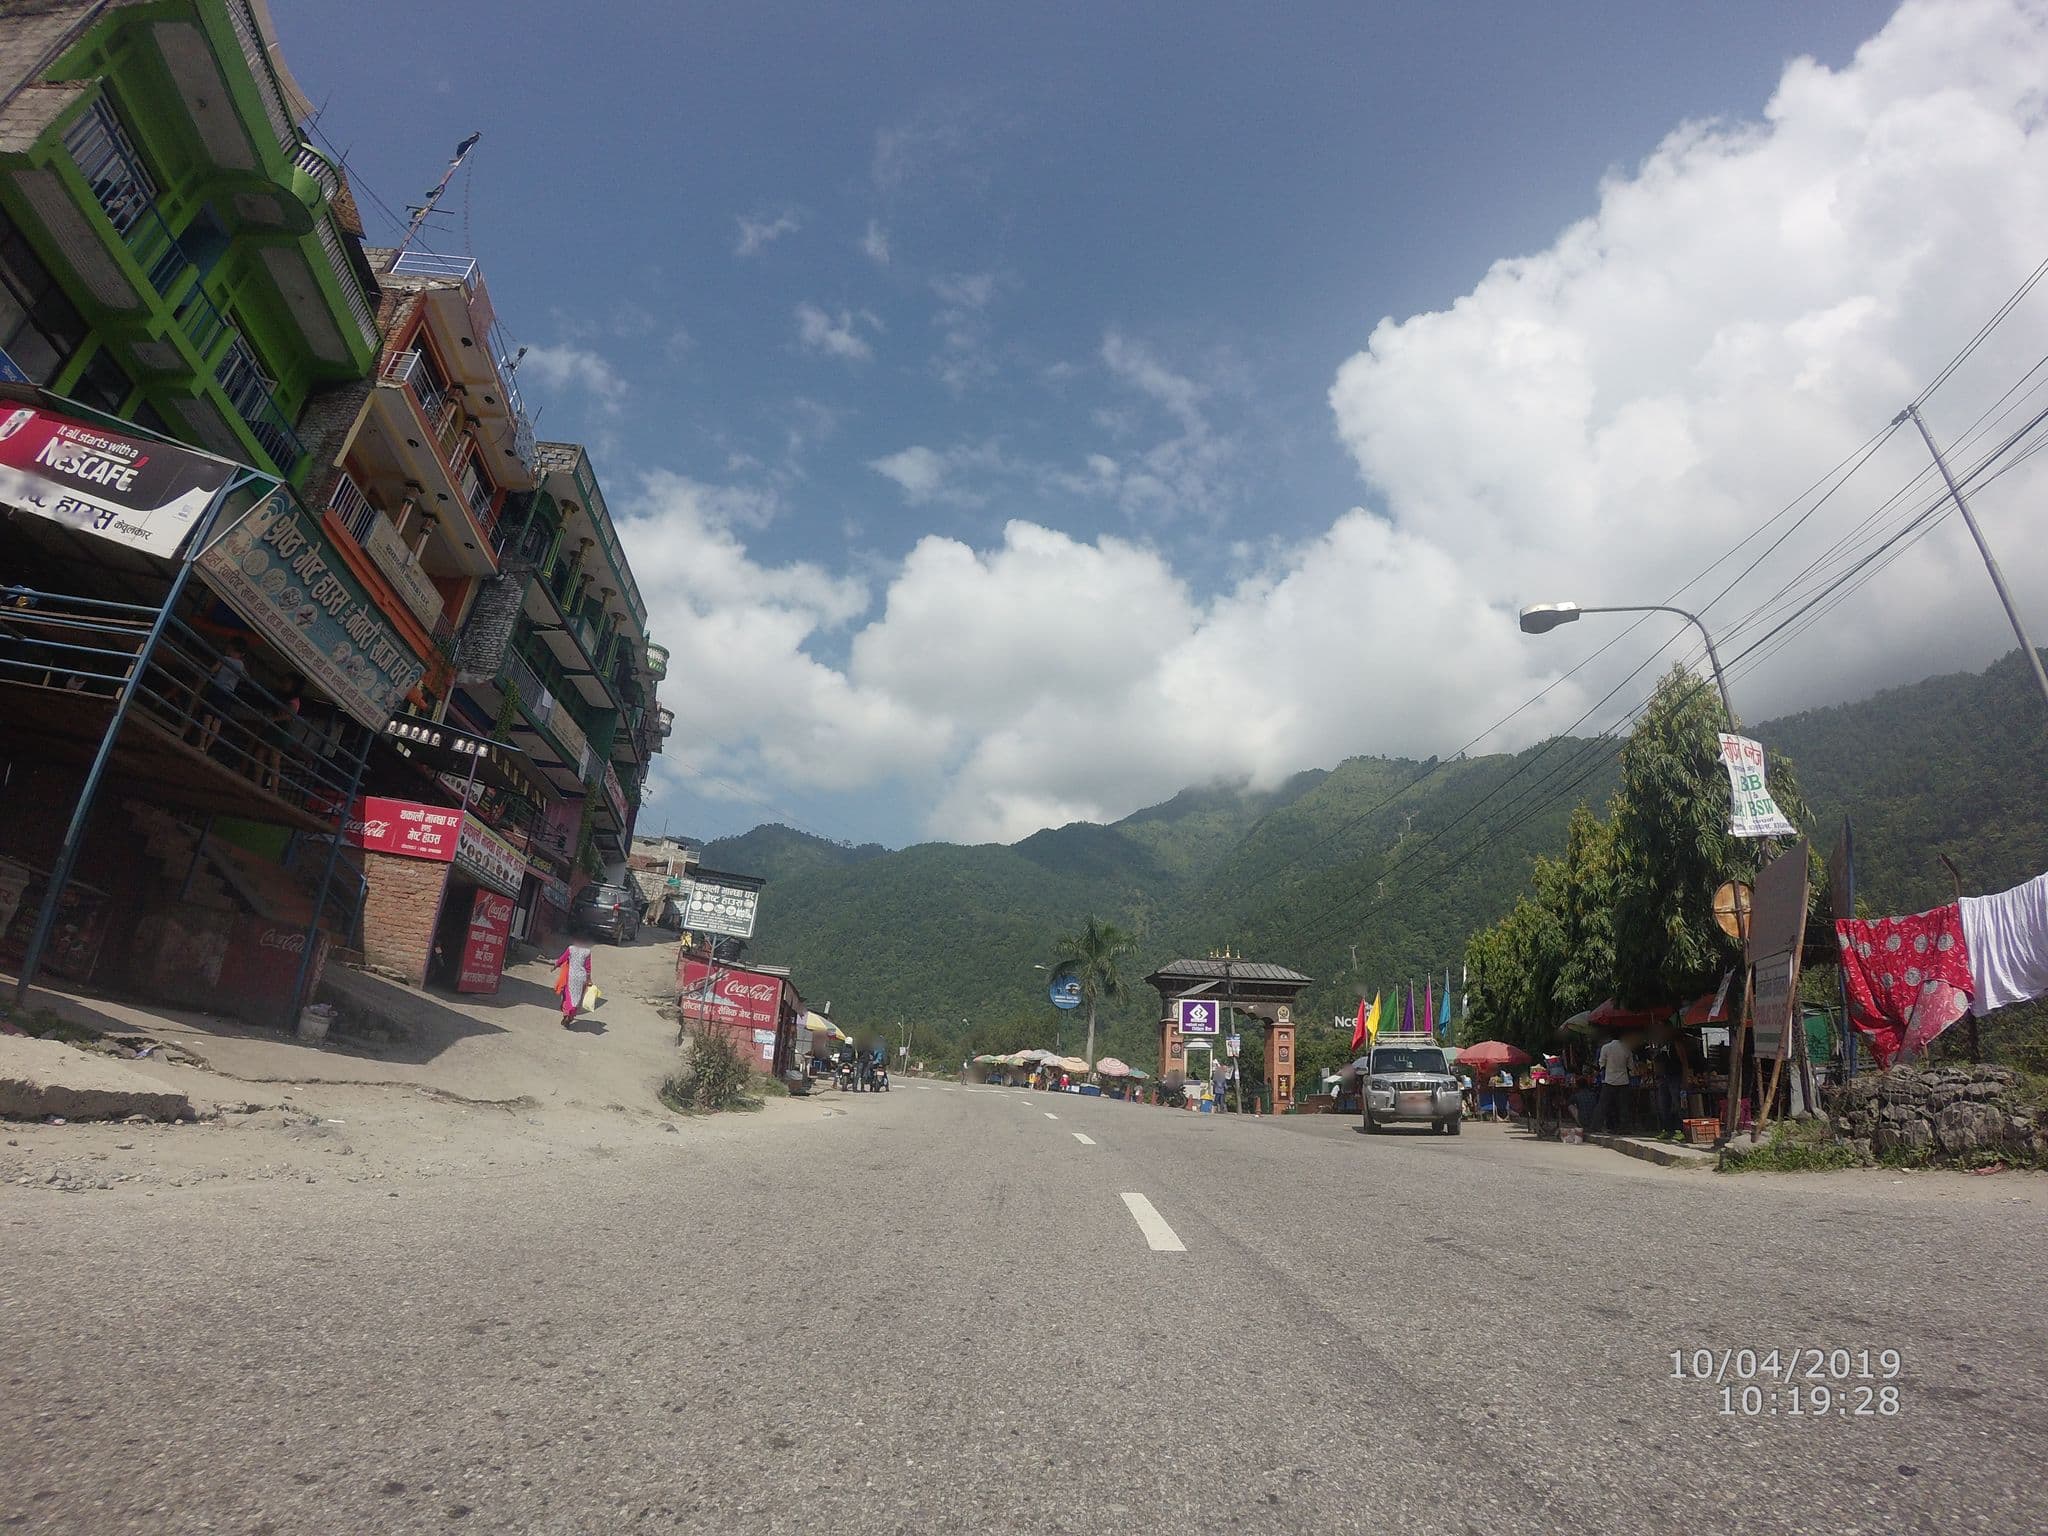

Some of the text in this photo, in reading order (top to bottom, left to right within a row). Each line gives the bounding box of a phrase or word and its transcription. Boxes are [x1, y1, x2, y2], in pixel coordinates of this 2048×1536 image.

[57, 424, 140, 459] It all starts with a
[310, 568, 351, 618] हाउस
[421, 833, 442, 845] हाउस
[724, 979, 777, 1002] Coca-Cola
